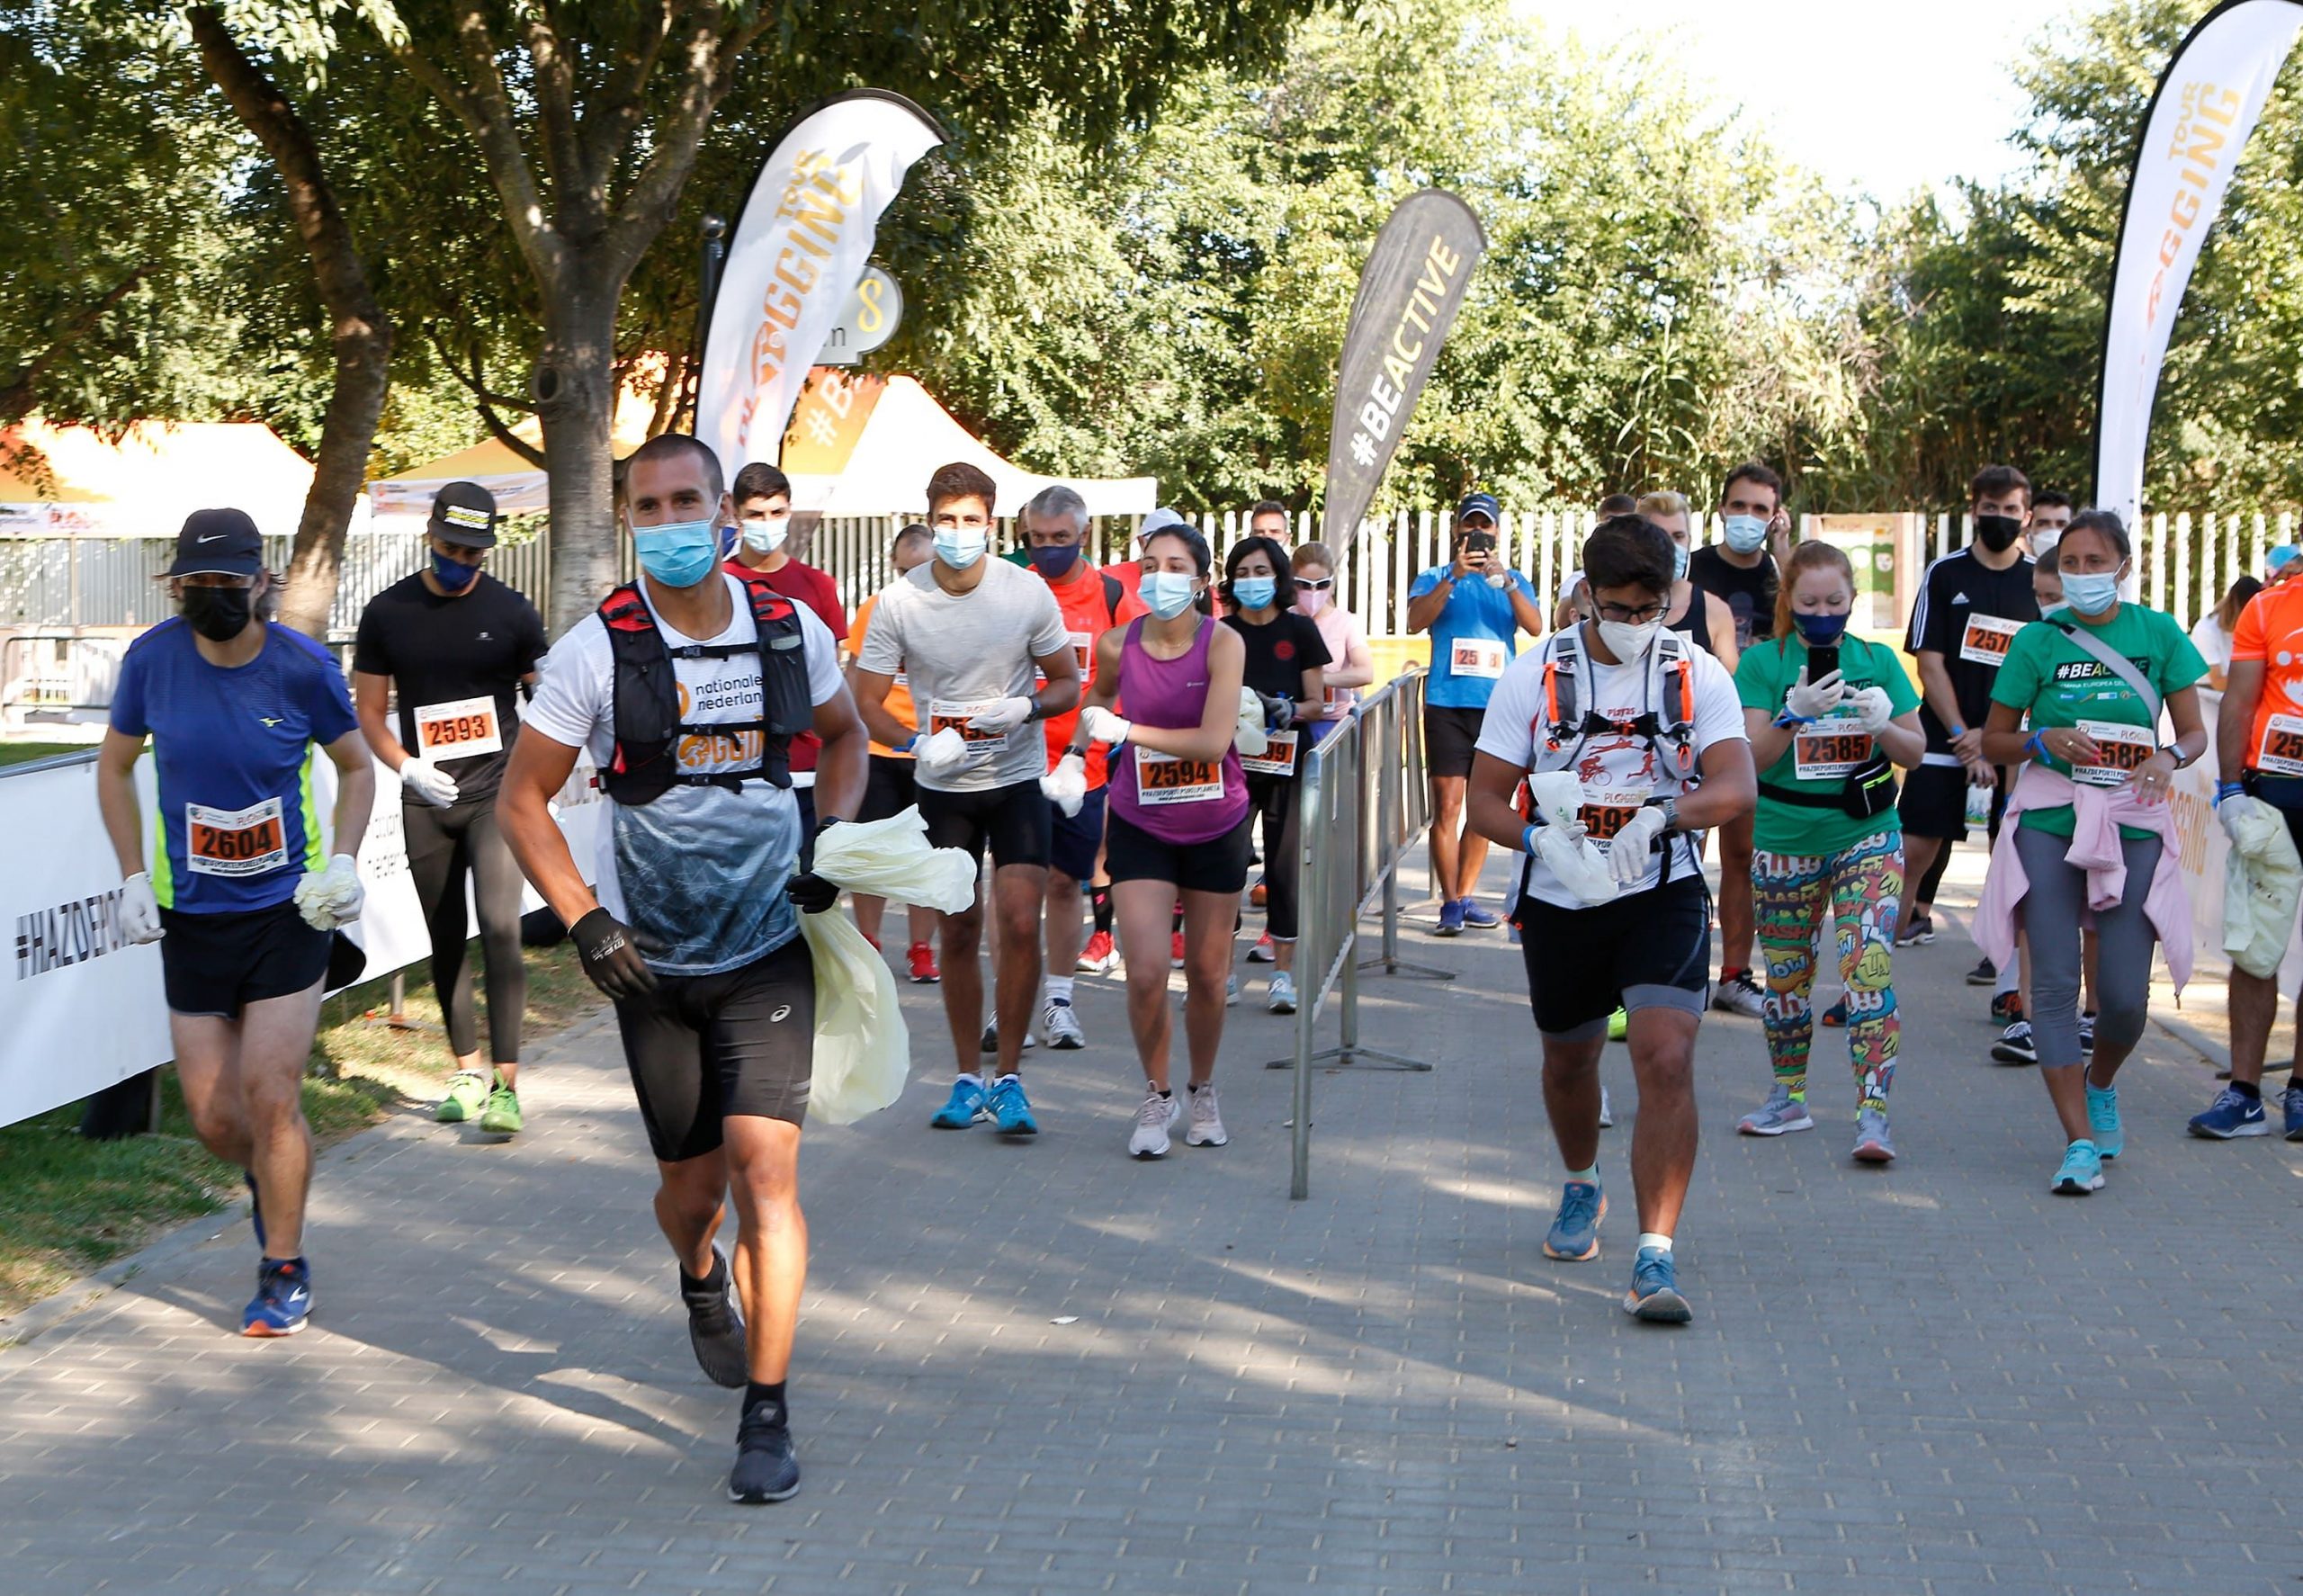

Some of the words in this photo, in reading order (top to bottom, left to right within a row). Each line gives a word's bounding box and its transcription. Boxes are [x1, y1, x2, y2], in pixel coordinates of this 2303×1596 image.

[2168, 81, 2200, 160] TOUR
[774, 148, 817, 221] TOUR
[1350, 235, 1459, 467] #BEACTIVE
[1973, 629, 2013, 654] 257
[695, 674, 763, 695] nationale
[427, 715, 486, 746] 2593
[1806, 735, 1866, 763] 2585
[2092, 739, 2146, 768] 586
[1148, 759, 1211, 787] 2594
[201, 822, 273, 858] 2604
